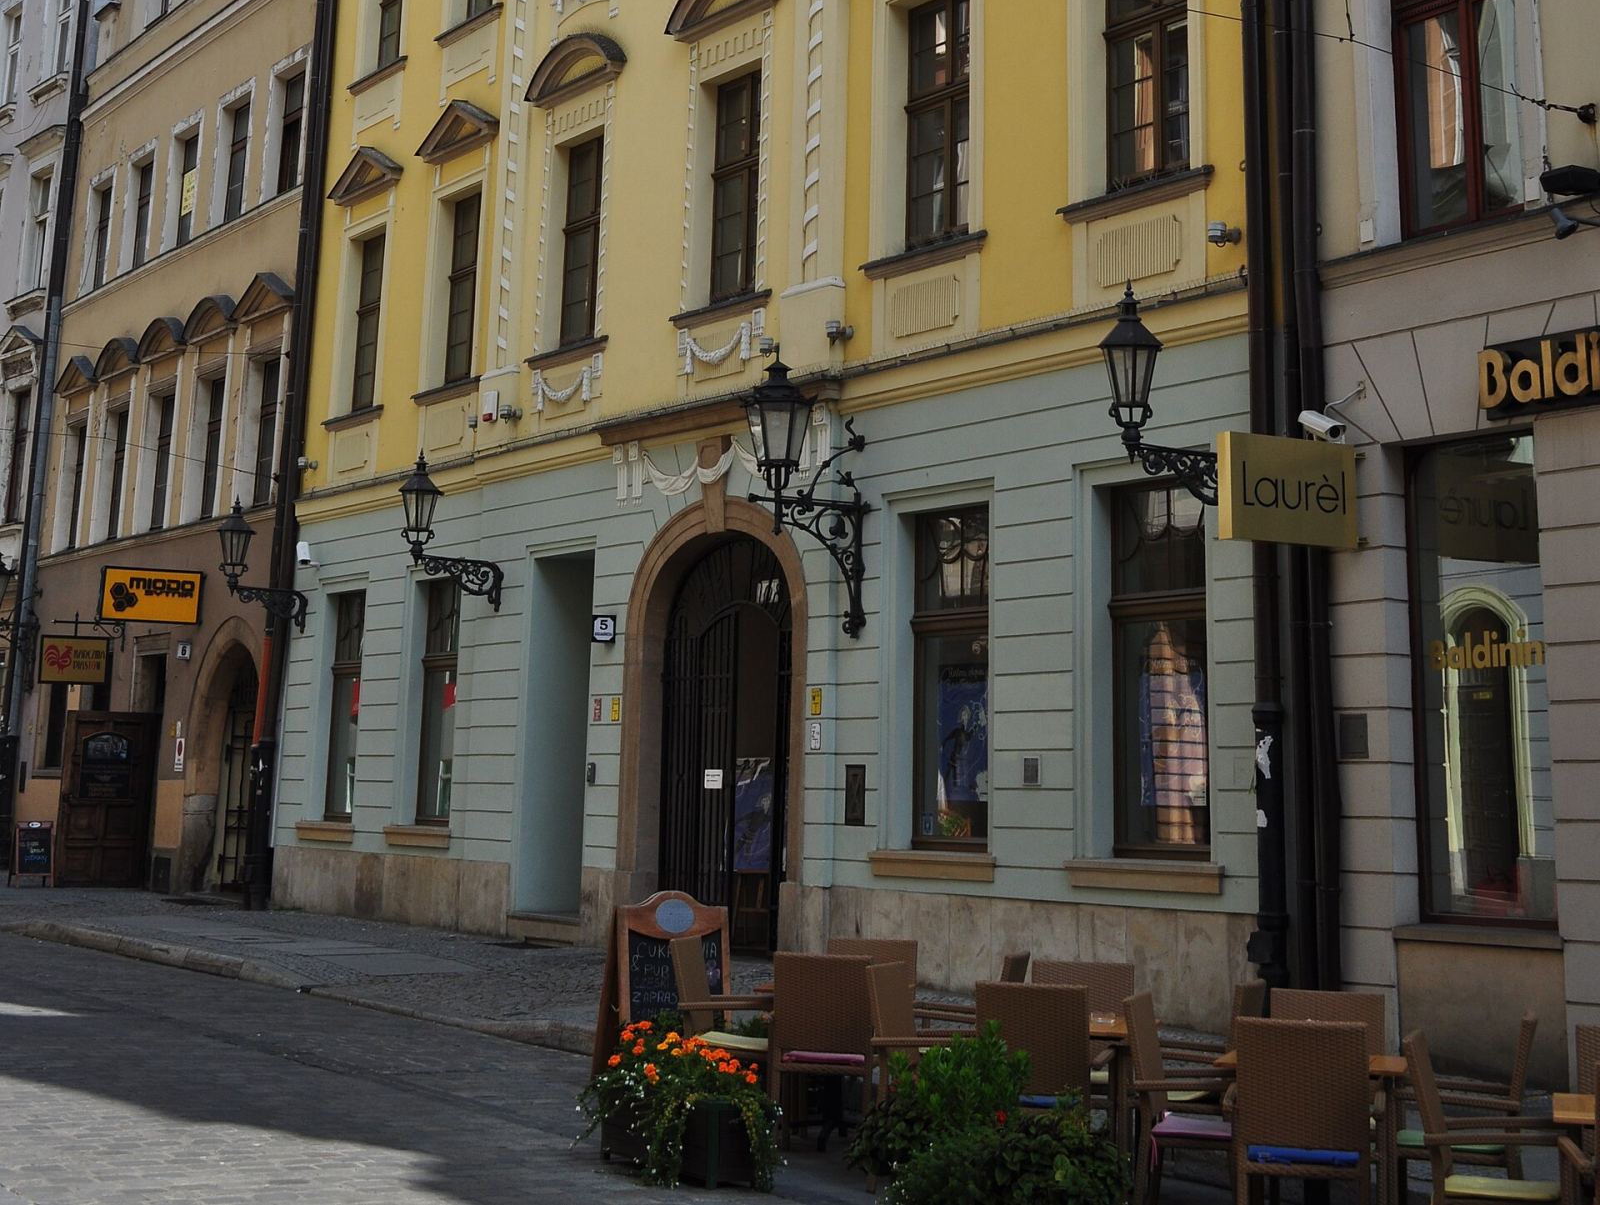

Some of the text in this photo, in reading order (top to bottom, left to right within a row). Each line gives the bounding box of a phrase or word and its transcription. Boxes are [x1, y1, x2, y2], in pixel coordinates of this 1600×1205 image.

[1242, 460, 1346, 515] Laurèl
[600, 620, 609, 630] 5
[181, 646, 187, 656] 6
